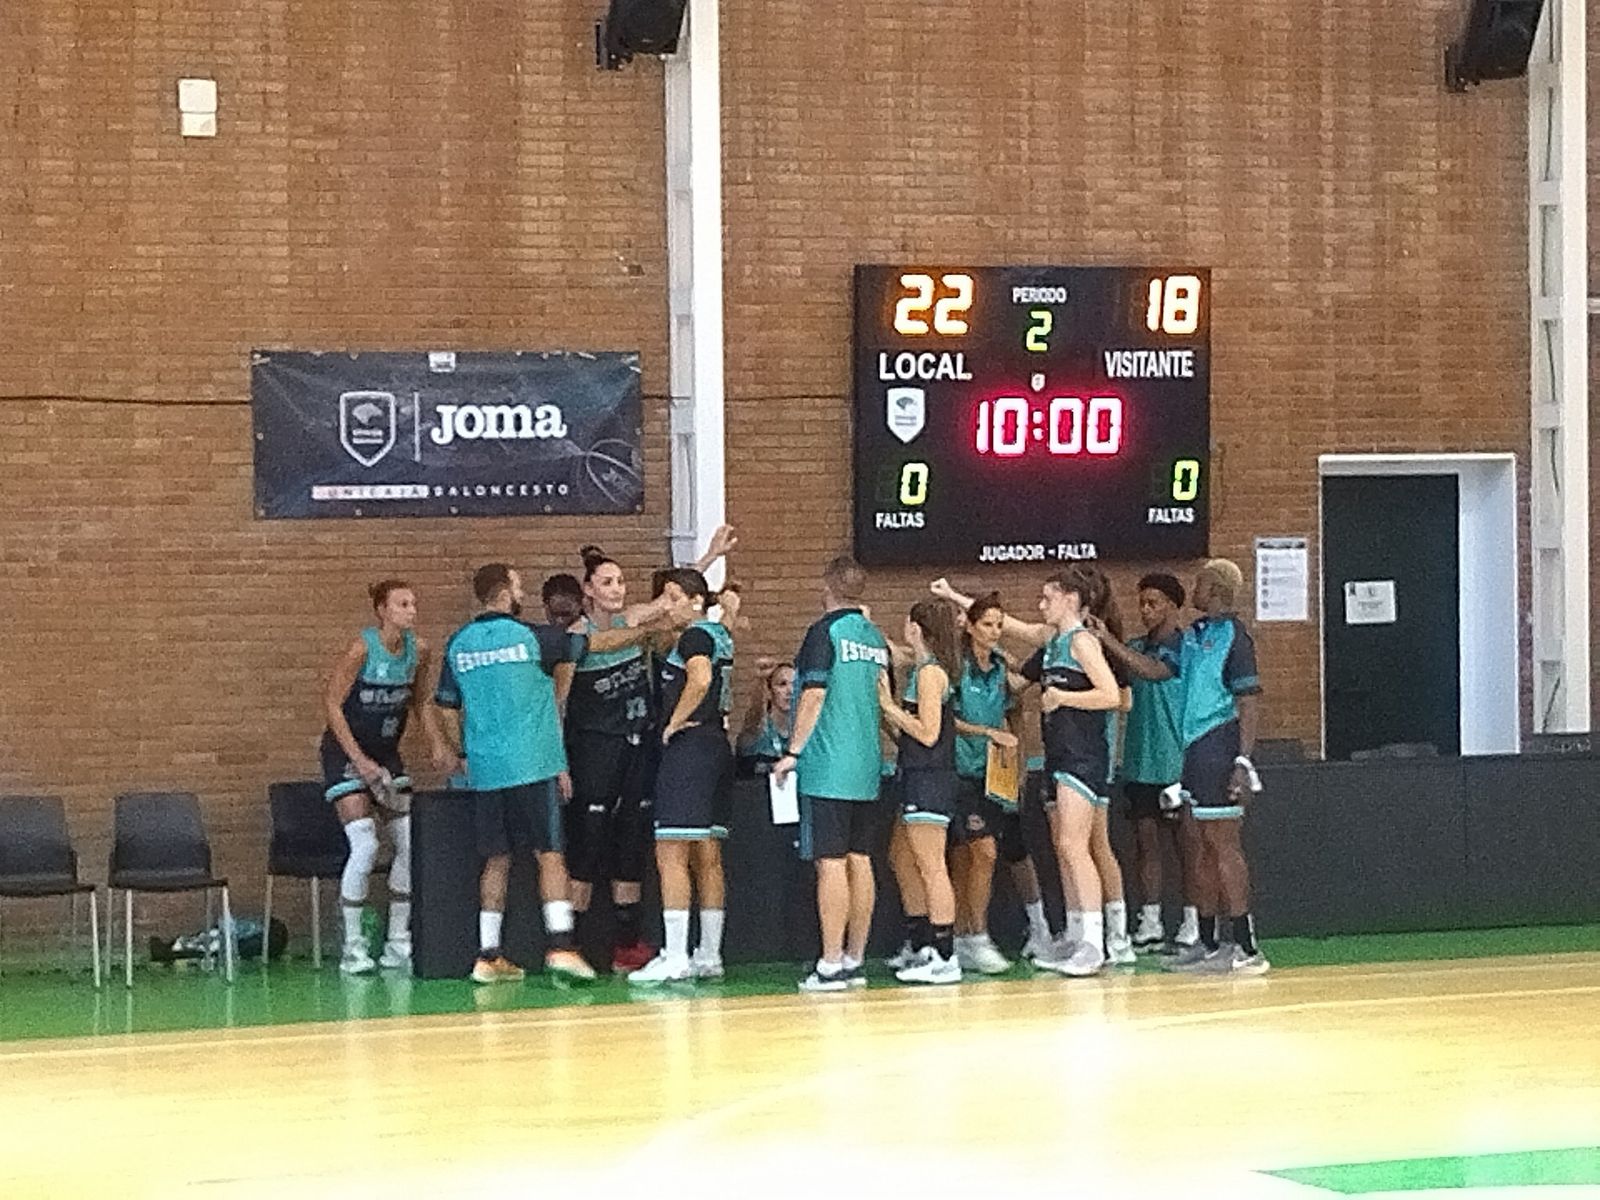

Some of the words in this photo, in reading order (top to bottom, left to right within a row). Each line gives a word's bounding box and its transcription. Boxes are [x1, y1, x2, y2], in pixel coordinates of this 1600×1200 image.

[893, 273, 973, 335] 22
[1012, 286, 1067, 303] PERIODO
[1146, 274, 1201, 335] 18
[1025, 310, 1052, 351] 2
[879, 352, 972, 380] LOCAL
[1104, 350, 1195, 379] VISITANTE
[975, 397, 1124, 455] 10:00
[433, 484, 568, 497] BALONCESTO
[900, 462, 929, 506] 0
[1172, 460, 1200, 501] 0
[875, 512, 925, 528] FALTAS
[1148, 507, 1195, 523] FALTAS
[979, 544, 1045, 562] JUGADOR
[1057, 543, 1097, 560] FALTA
